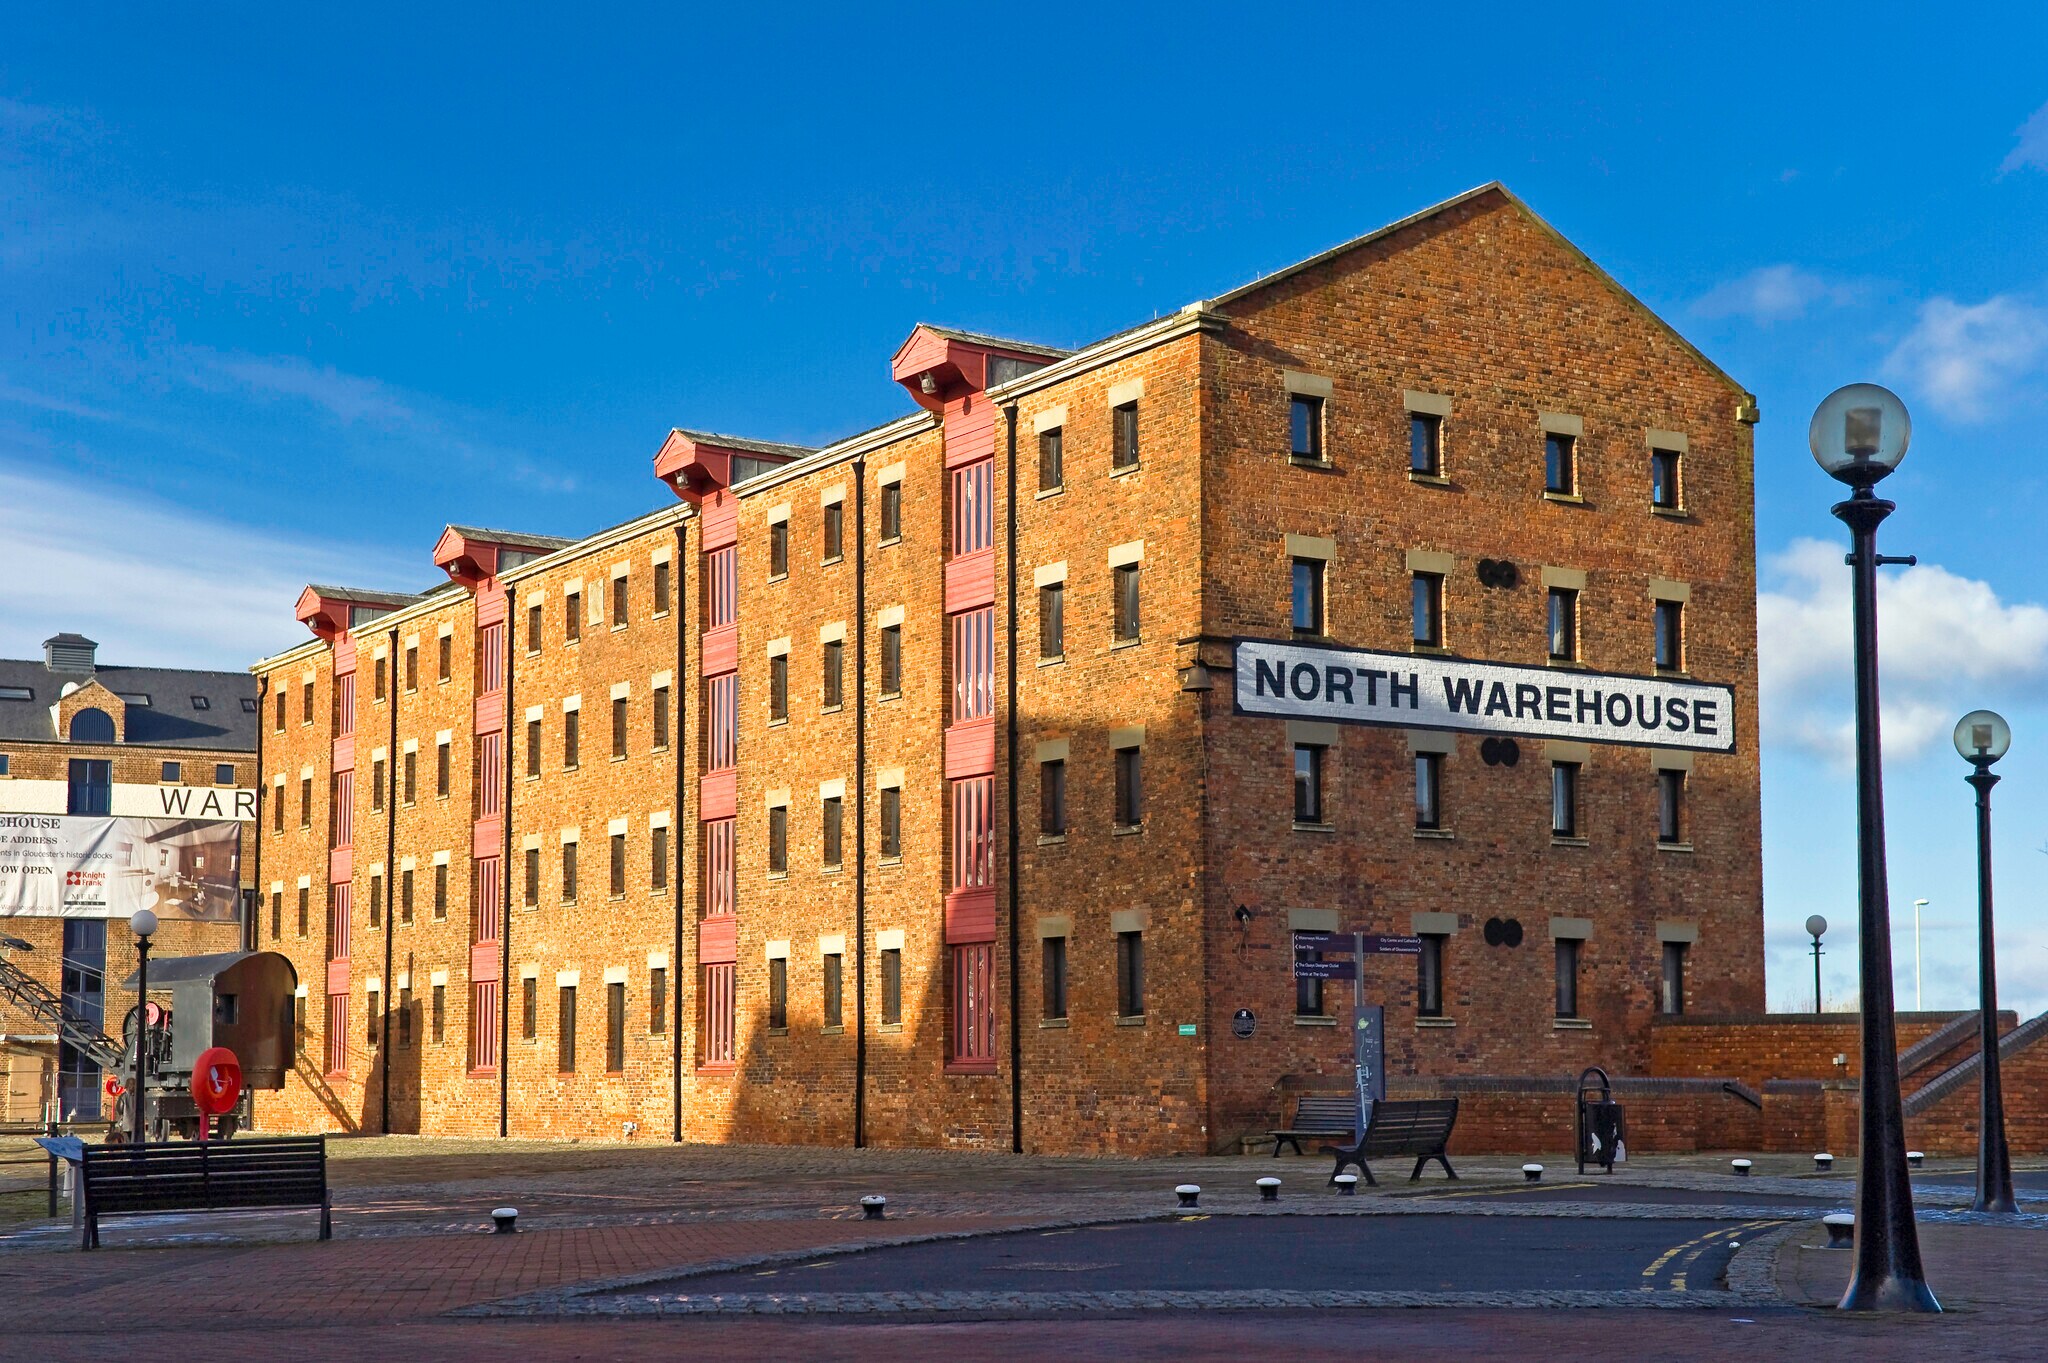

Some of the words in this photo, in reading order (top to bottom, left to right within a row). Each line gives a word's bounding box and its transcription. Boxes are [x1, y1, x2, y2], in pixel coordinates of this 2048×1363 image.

[1255, 658, 1419, 710] NORTH
[1443, 676, 1718, 736] WAREHOUSE
[160, 787, 256, 818] WAR
[10, 836, 58, 845] ADDRESS
[13, 849, 20, 857] in
[22, 849, 65, 858] Gloucester's
[66, 851, 91, 859] historic
[92, 852, 113, 860] docks
[0, 865, 19, 874] OW
[22, 865, 54, 875] OPEN
[82, 871, 106, 880] Knight
[82, 879, 102, 887] Frank
